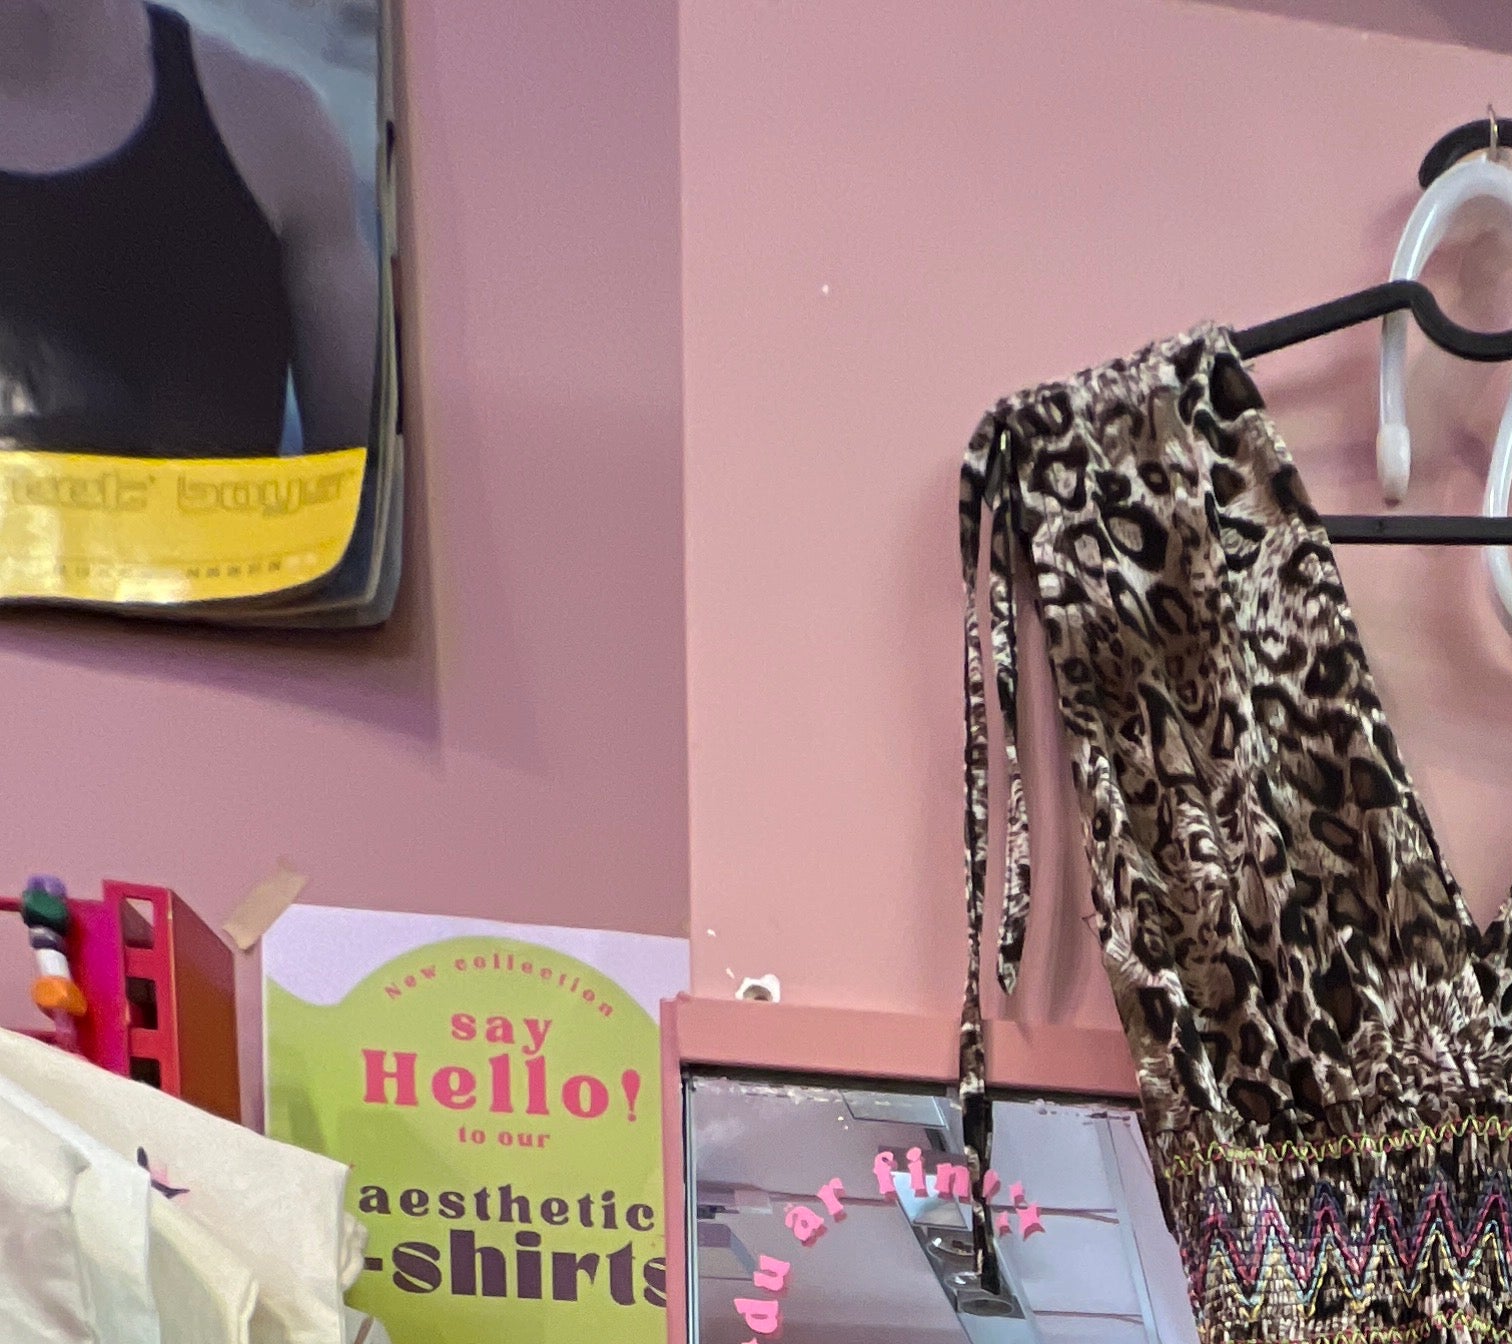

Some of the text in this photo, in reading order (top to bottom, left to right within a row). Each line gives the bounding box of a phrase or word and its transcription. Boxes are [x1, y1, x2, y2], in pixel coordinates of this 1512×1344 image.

[385, 953, 613, 1017] New collection
[451, 1012, 552, 1055] say
[361, 1049, 641, 1122] Hello!
[458, 1126, 551, 1148] to our
[358, 1184, 654, 1231] aesthetic
[364, 1229, 666, 1307] -shirts
